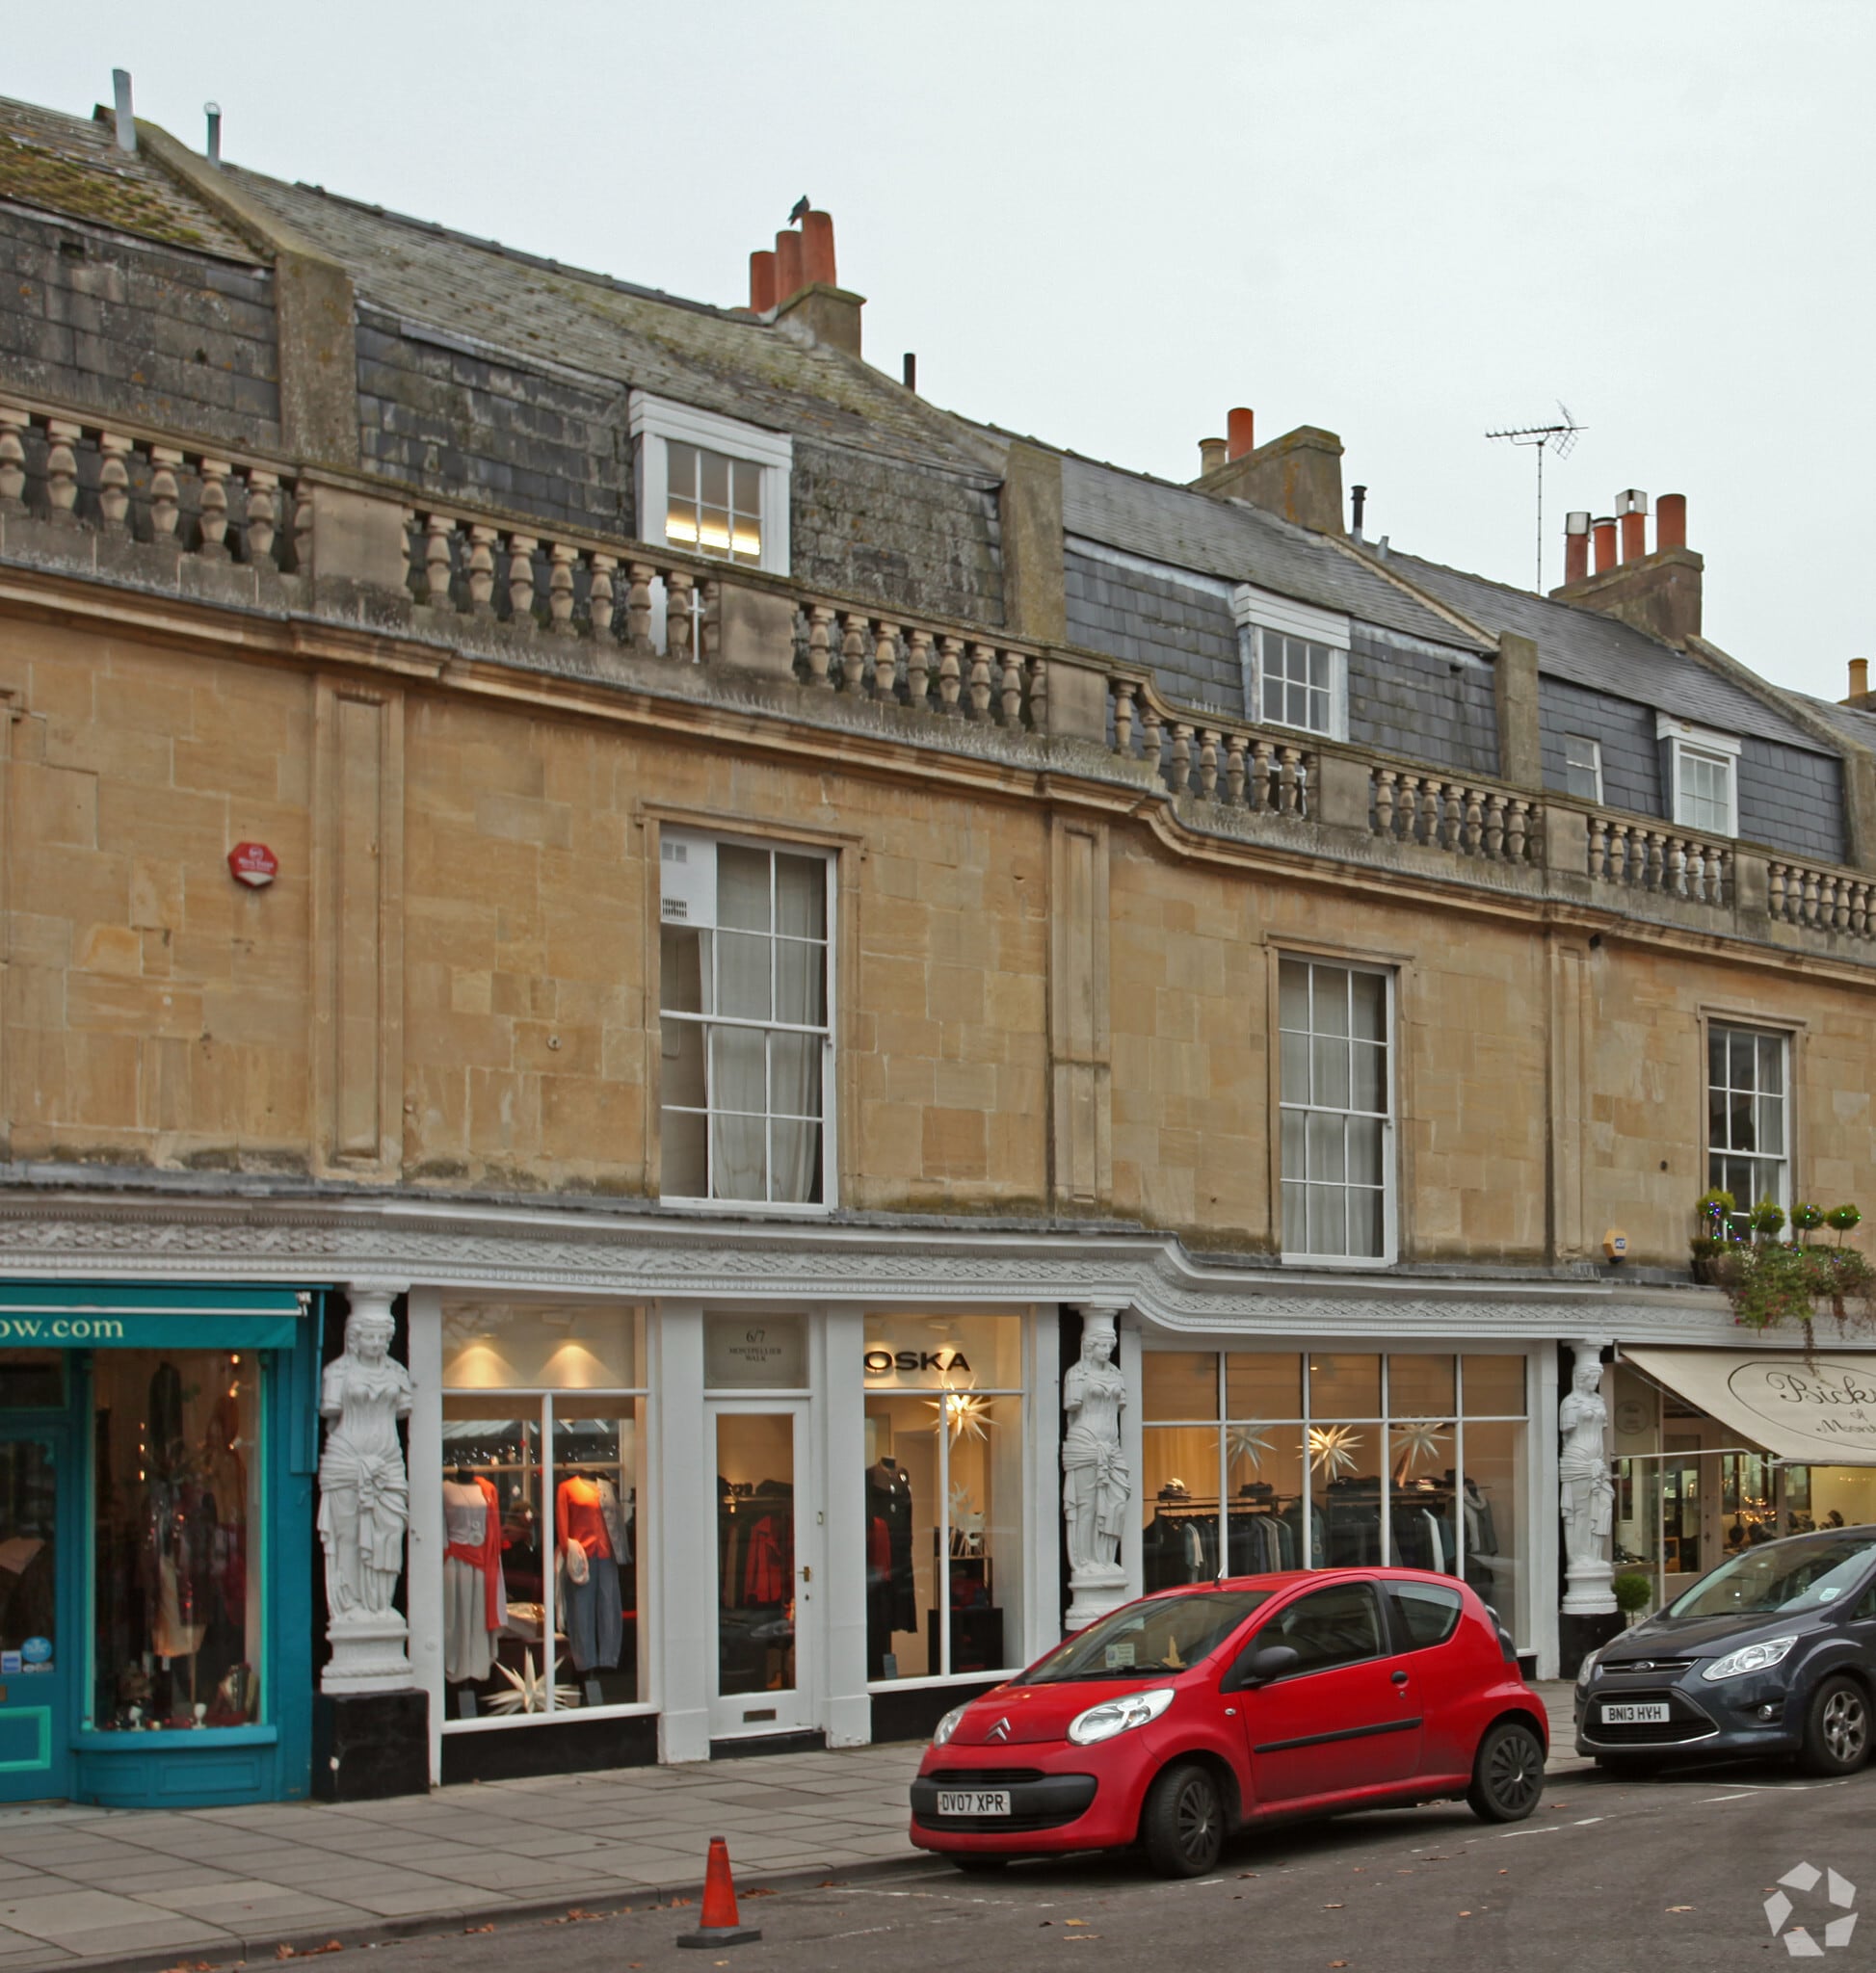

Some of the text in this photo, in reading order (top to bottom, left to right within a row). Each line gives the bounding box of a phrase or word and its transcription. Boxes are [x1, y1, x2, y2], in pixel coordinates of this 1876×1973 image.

[863, 1351, 971, 1372] OSKA
[1608, 1705, 1662, 1722] BN13 HVH
[976, 1794, 1004, 1812] XPR
